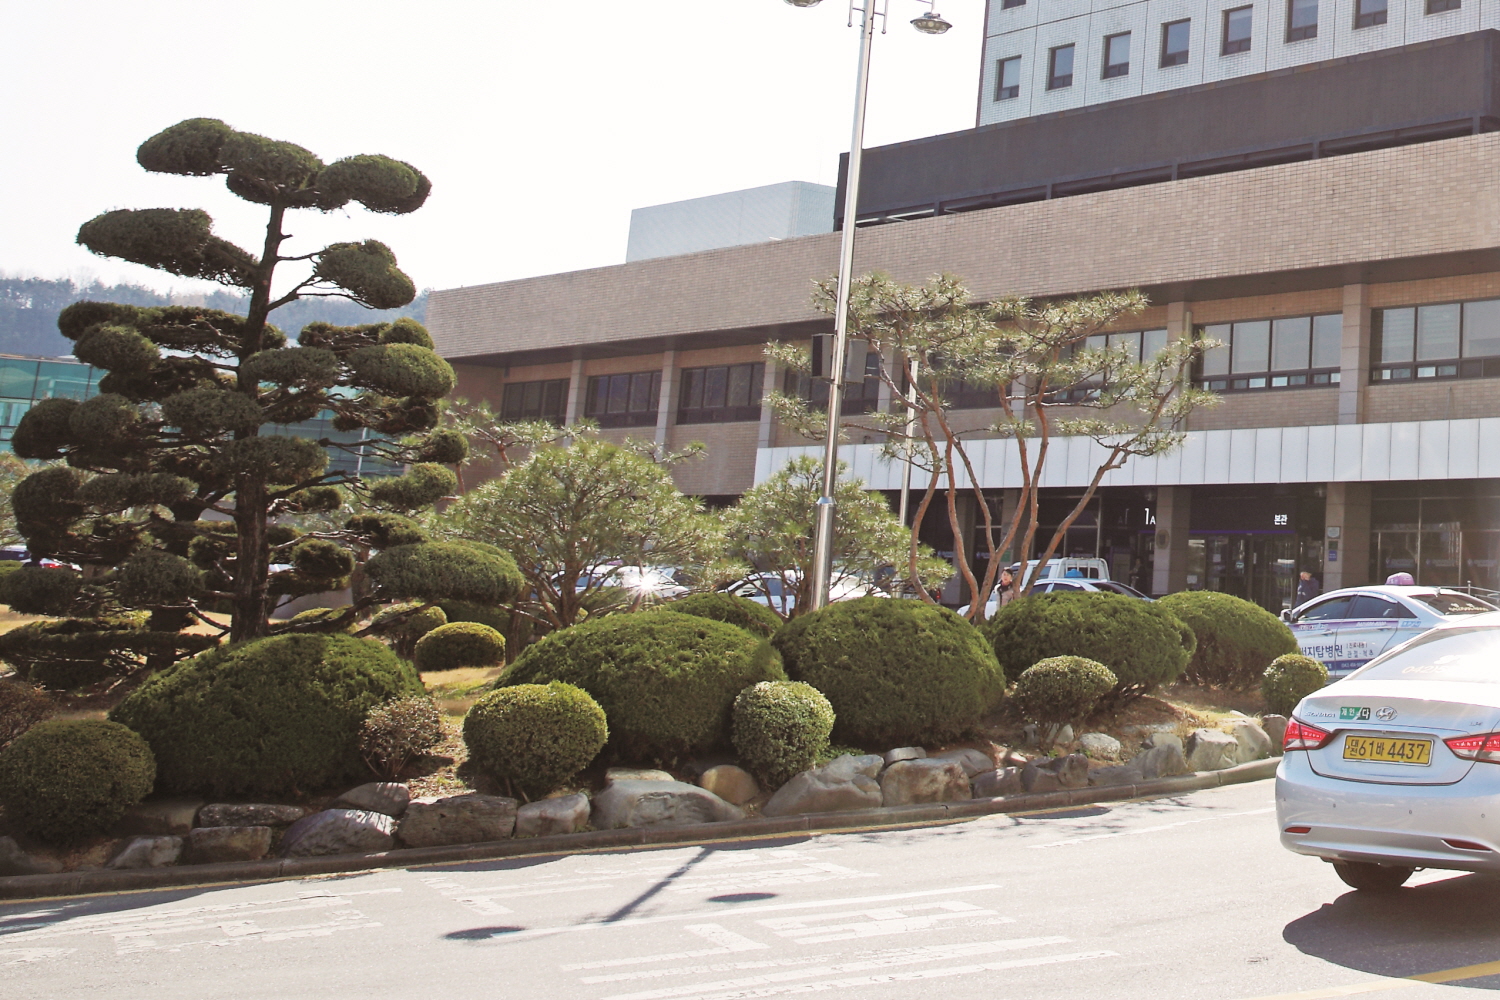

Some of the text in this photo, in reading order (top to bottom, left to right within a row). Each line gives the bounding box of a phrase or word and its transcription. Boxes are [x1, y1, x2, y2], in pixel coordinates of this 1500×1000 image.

[1274, 514, 1288, 525] 본관
[1358, 740, 1385, 757] 61바
[1387, 741, 1425, 760] 4437
